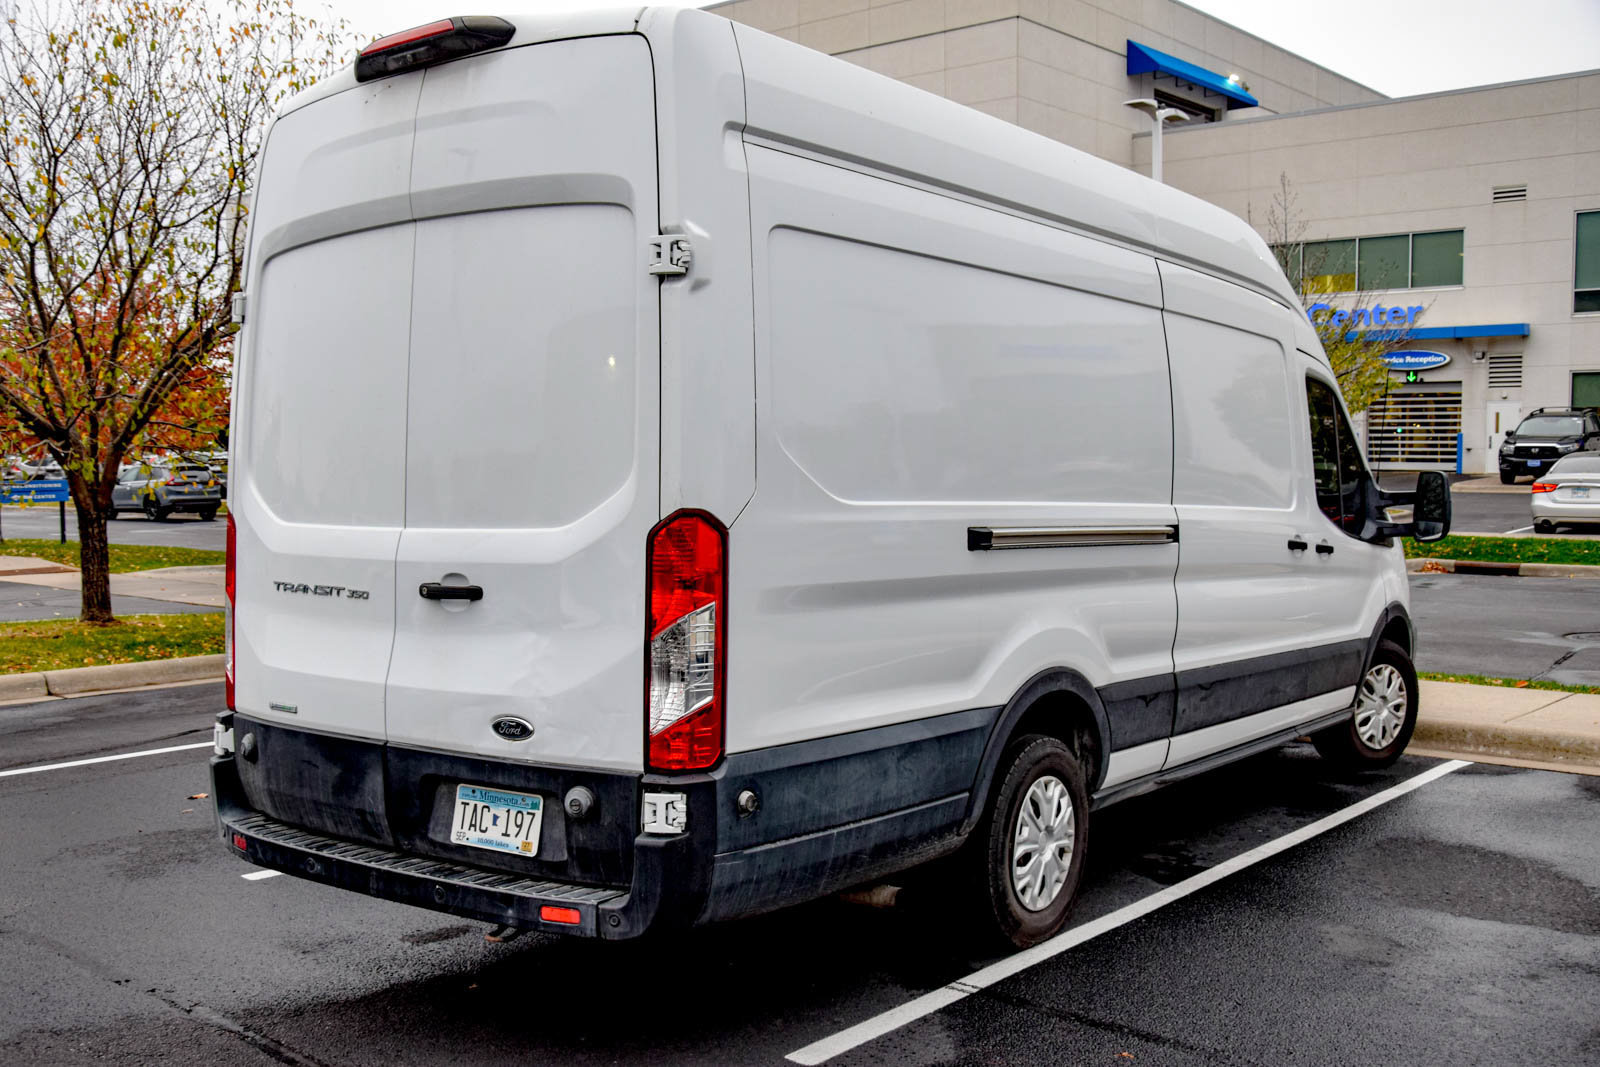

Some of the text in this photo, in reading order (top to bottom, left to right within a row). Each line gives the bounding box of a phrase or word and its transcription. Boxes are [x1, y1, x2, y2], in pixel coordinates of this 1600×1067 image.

[1307, 302, 1424, 327] Center
[1405, 355, 1445, 364] Reception
[273, 581, 370, 600] TRANSIT 350
[498, 720, 522, 735] Ford
[460, 801, 537, 841] TAC 197
